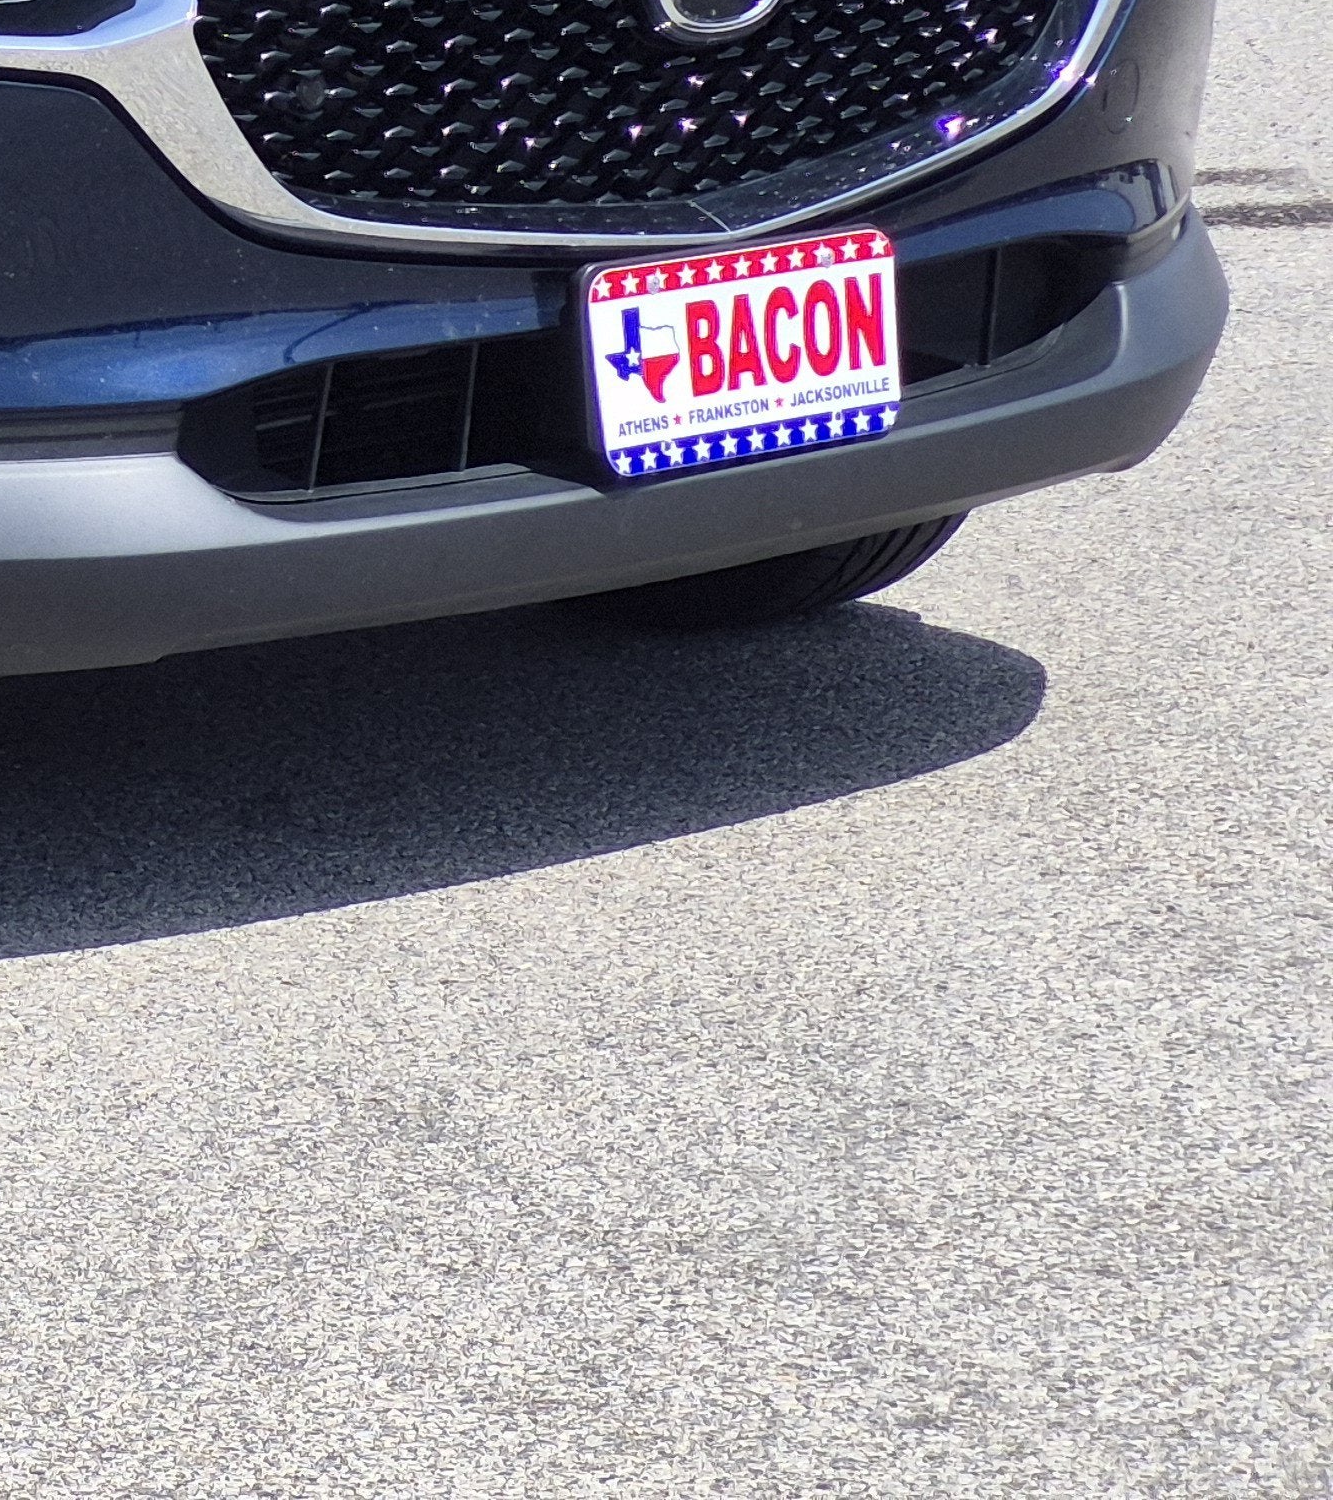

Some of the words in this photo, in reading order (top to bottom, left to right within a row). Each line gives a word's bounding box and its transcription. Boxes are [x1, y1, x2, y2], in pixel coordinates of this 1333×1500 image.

[686, 273, 886, 397] BACON
[618, 414, 670, 437] ATHENS
[688, 397, 770, 425] FRANKSTON
[790, 377, 891, 407] JACKSONVILLE
